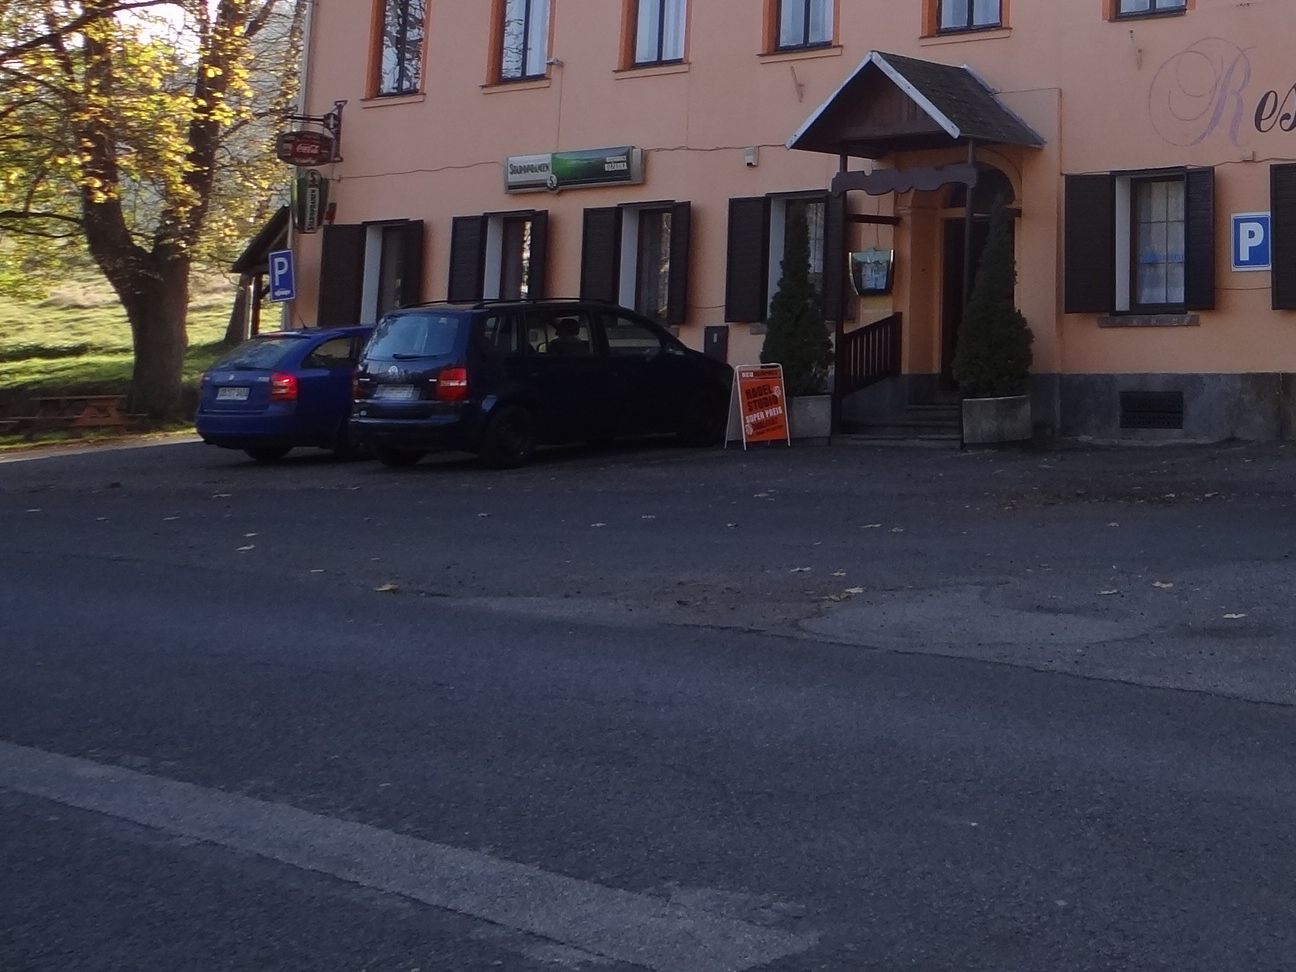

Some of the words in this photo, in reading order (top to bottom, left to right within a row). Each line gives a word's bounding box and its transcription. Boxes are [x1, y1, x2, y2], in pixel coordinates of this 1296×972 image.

[1239, 222, 1265, 262] P
[273, 257, 289, 286] P
[745, 411, 764, 423] SUPER
[765, 406, 783, 418] PREIS
[747, 395, 778, 412] STUDIO
